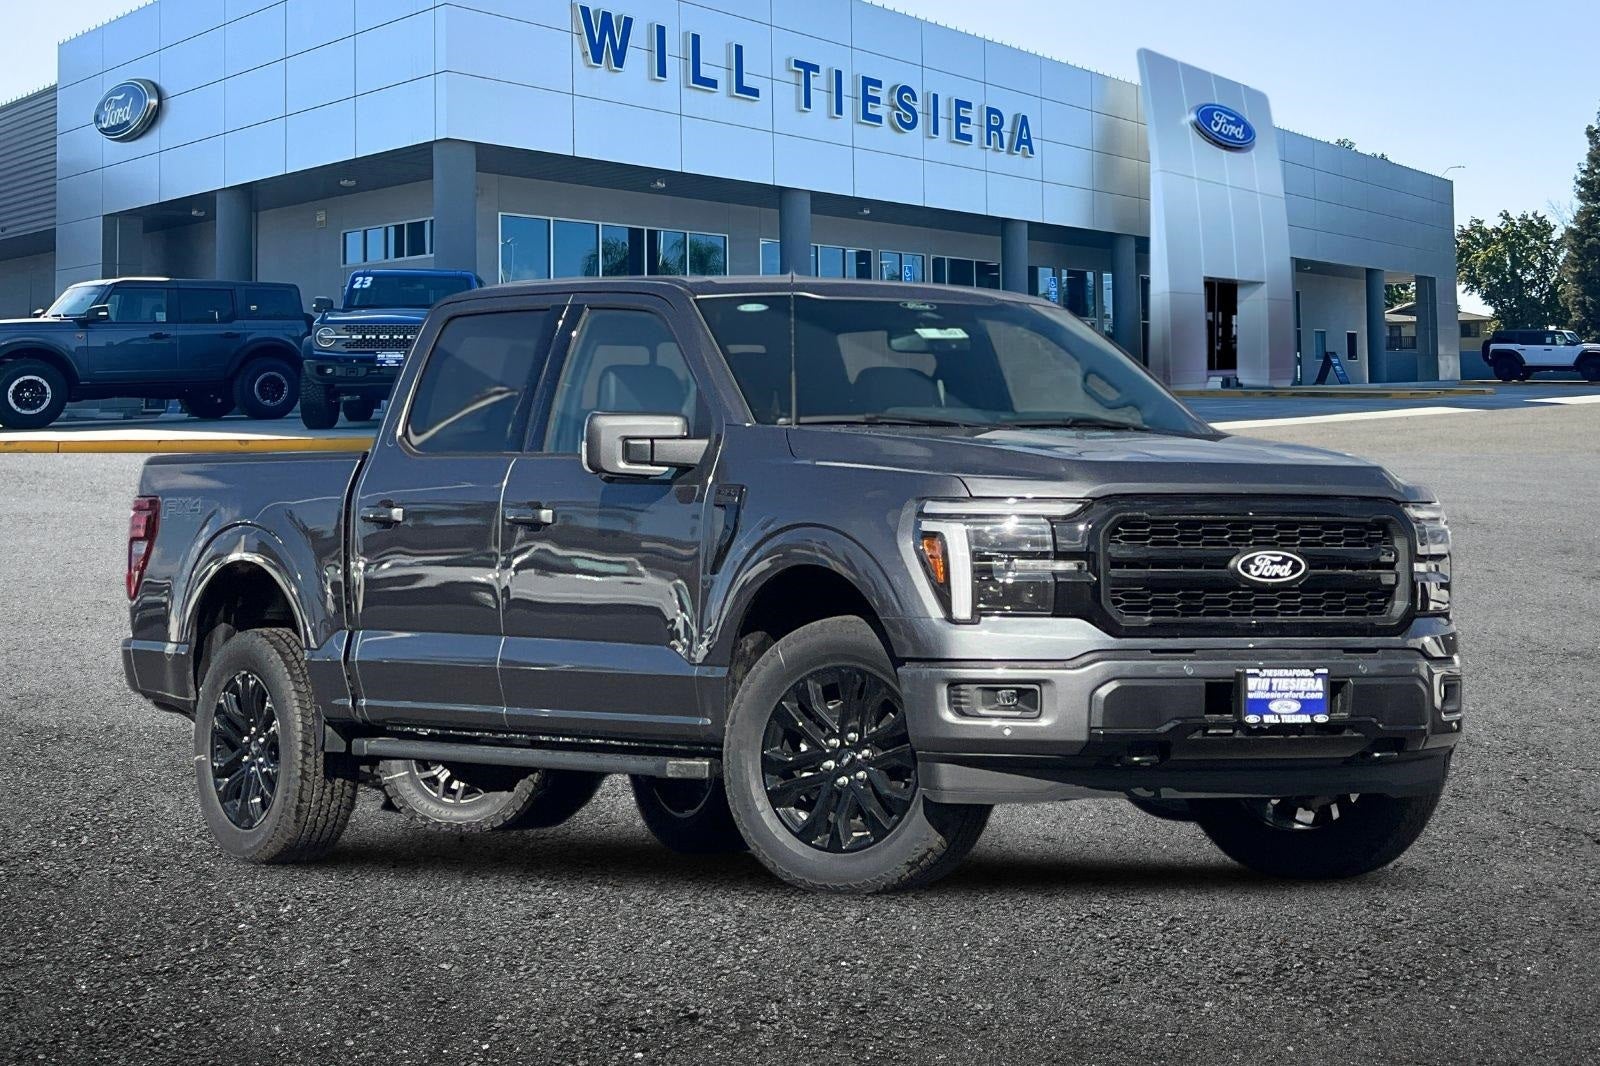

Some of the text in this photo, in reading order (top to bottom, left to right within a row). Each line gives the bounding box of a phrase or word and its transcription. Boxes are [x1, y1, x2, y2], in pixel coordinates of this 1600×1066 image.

[573, 4, 1035, 157] WILL TIESIERA
[102, 93, 132, 128] Ford
[1211, 110, 1245, 139] Ford
[353, 276, 373, 288] 23
[162, 497, 202, 519] FX4
[1249, 554, 1293, 577] Ford
[1272, 678, 1323, 691] TIESIERA
[1263, 715, 1280, 723] WILL
